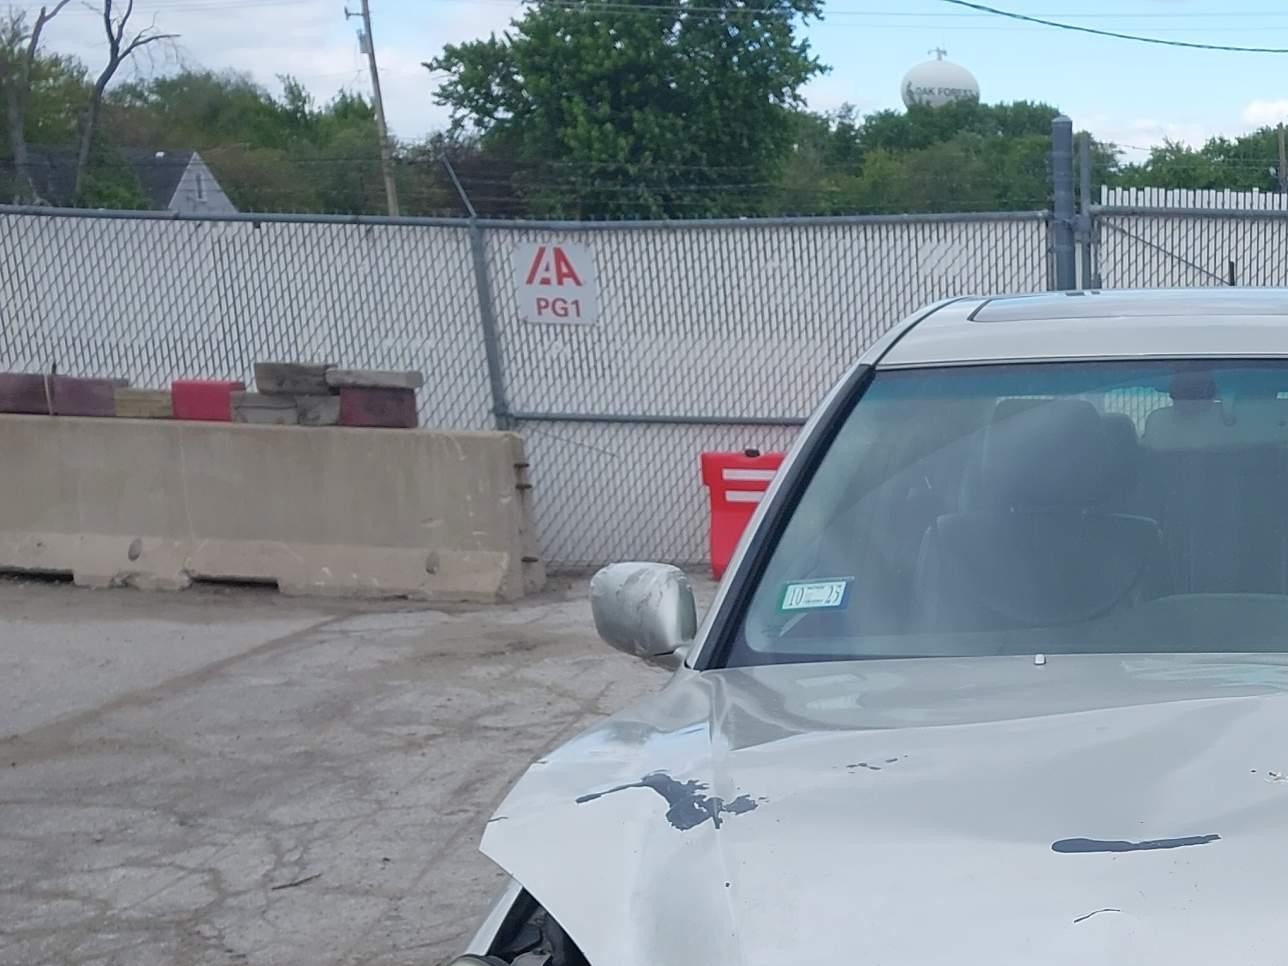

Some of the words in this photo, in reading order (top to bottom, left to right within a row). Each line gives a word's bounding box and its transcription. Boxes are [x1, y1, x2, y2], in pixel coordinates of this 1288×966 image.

[536, 297, 581, 318] PG1
[789, 586, 805, 606] 10
[824, 584, 843, 604] 25
